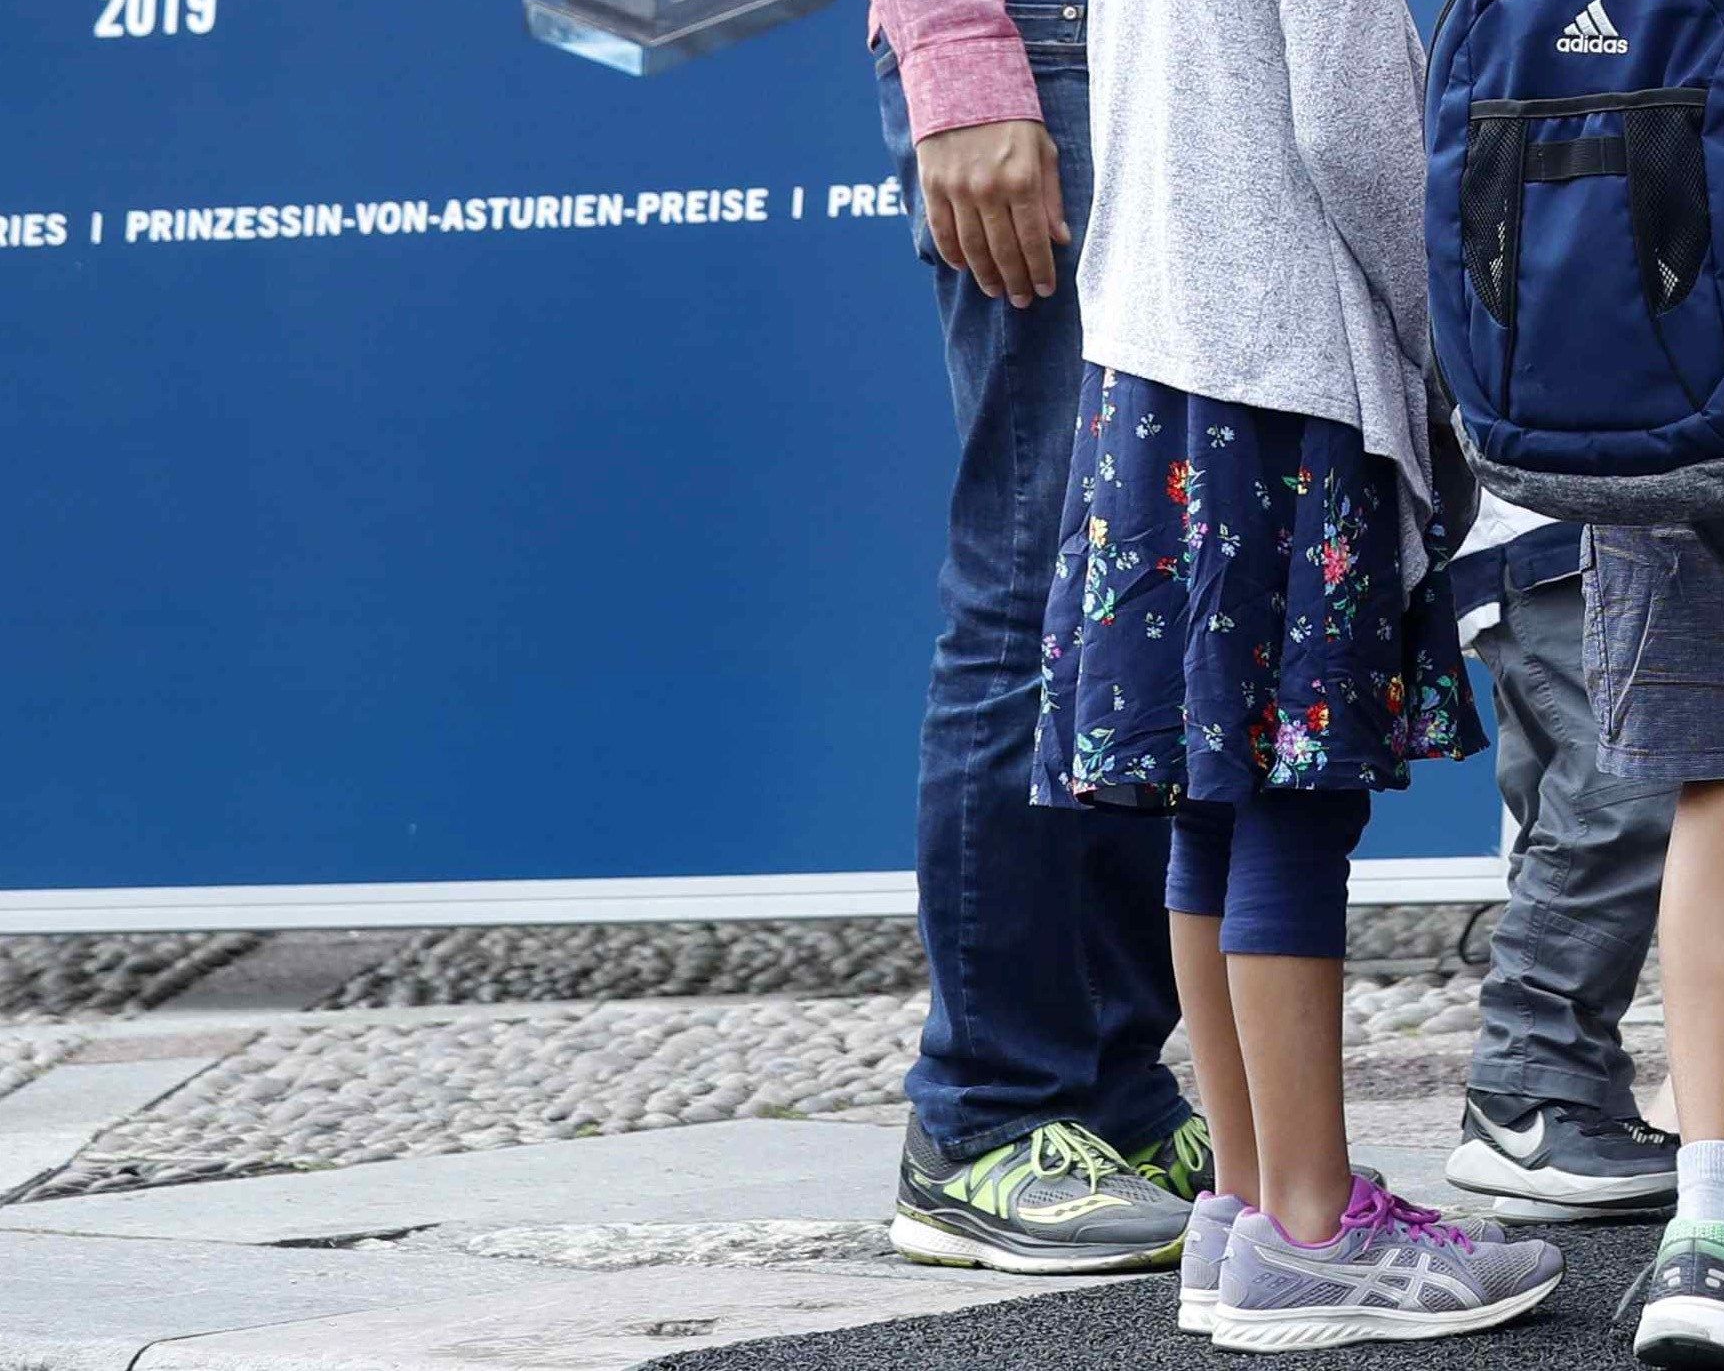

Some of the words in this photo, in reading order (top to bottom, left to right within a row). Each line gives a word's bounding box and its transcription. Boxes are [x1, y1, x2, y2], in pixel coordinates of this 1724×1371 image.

[1556, 33, 1629, 54] adidas
[125, 187, 770, 244] PRINZESSIN-VON-ASTURIEN-PREISE
[826, 175, 908, 218] PRÉ
